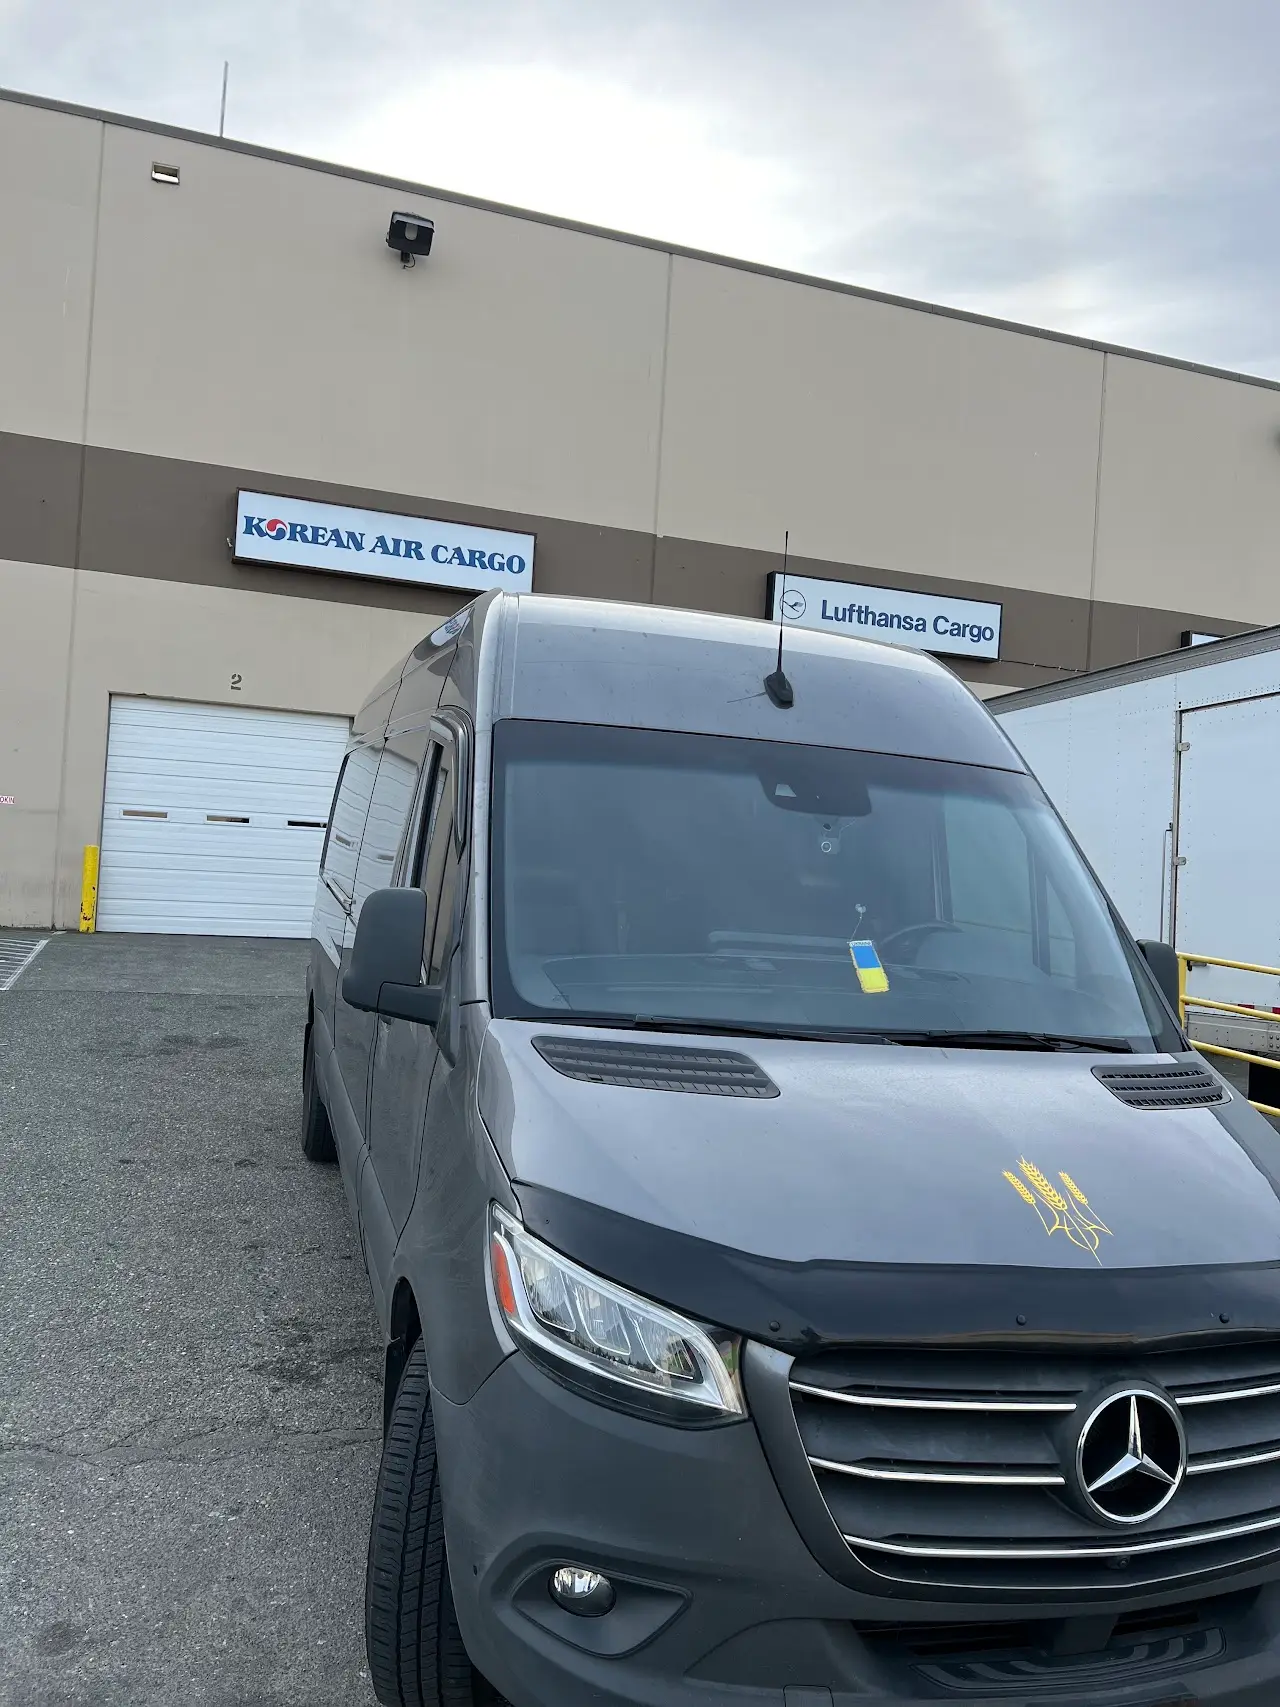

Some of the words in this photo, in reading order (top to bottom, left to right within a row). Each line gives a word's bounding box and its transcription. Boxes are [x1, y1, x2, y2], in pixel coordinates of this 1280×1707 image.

[243, 515, 366, 552] KOREAN
[368, 534, 425, 561] AIR
[430, 544, 526, 575] CARGO
[821, 599, 927, 633] Lufthansa
[932, 615, 995, 643] Cargo
[230, 673, 242, 691] 2
